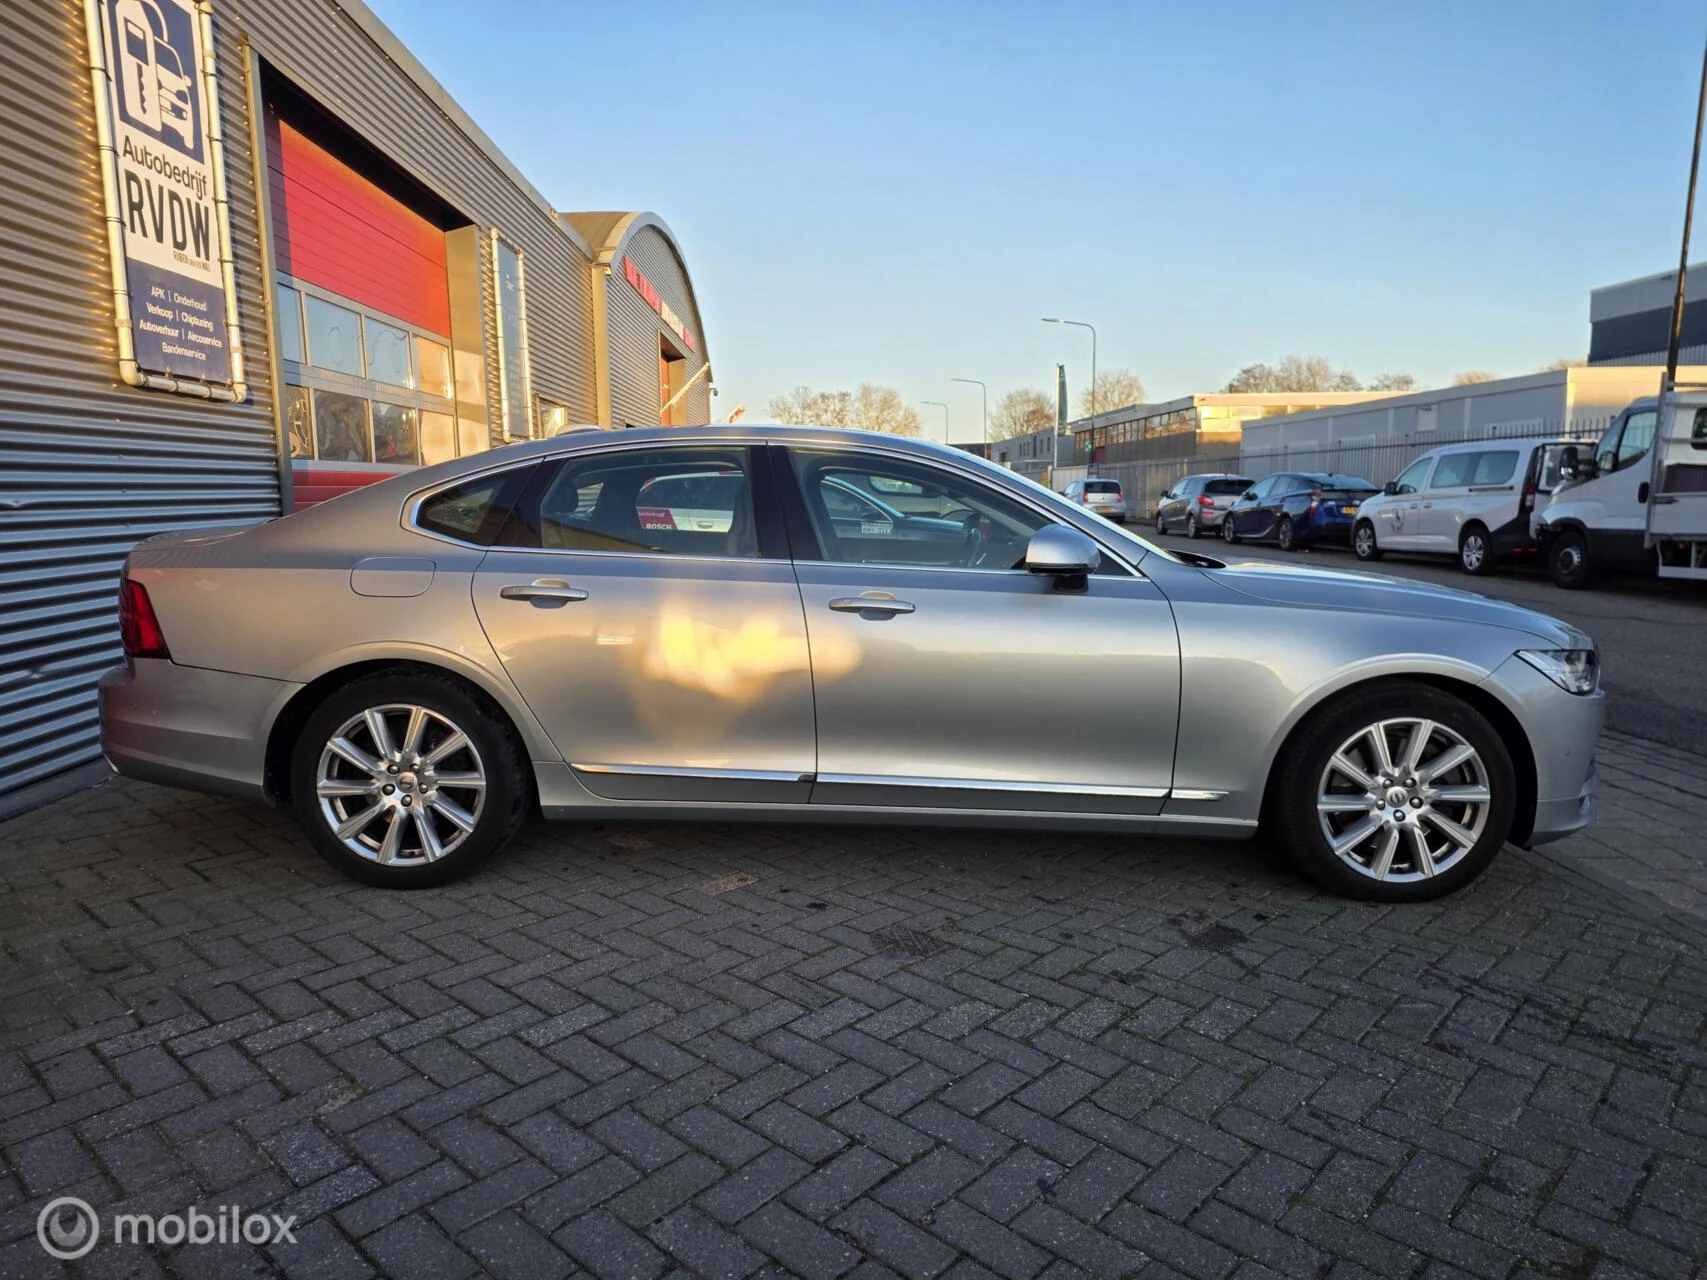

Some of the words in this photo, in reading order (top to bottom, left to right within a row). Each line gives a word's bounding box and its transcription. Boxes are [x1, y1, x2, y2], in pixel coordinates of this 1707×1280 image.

[123, 135, 207, 201] Autobedrijf
[124, 168, 210, 262] RVDW
[151, 286, 165, 300] APK
[173, 292, 207, 312] Onderhoud
[146, 302, 174, 322] Verkoop
[181, 312, 214, 332] Chiptuning
[139, 319, 180, 338] Autoverhuur
[187, 331, 223, 349] Aircoservice
[161, 341, 207, 361] Bandenservice
